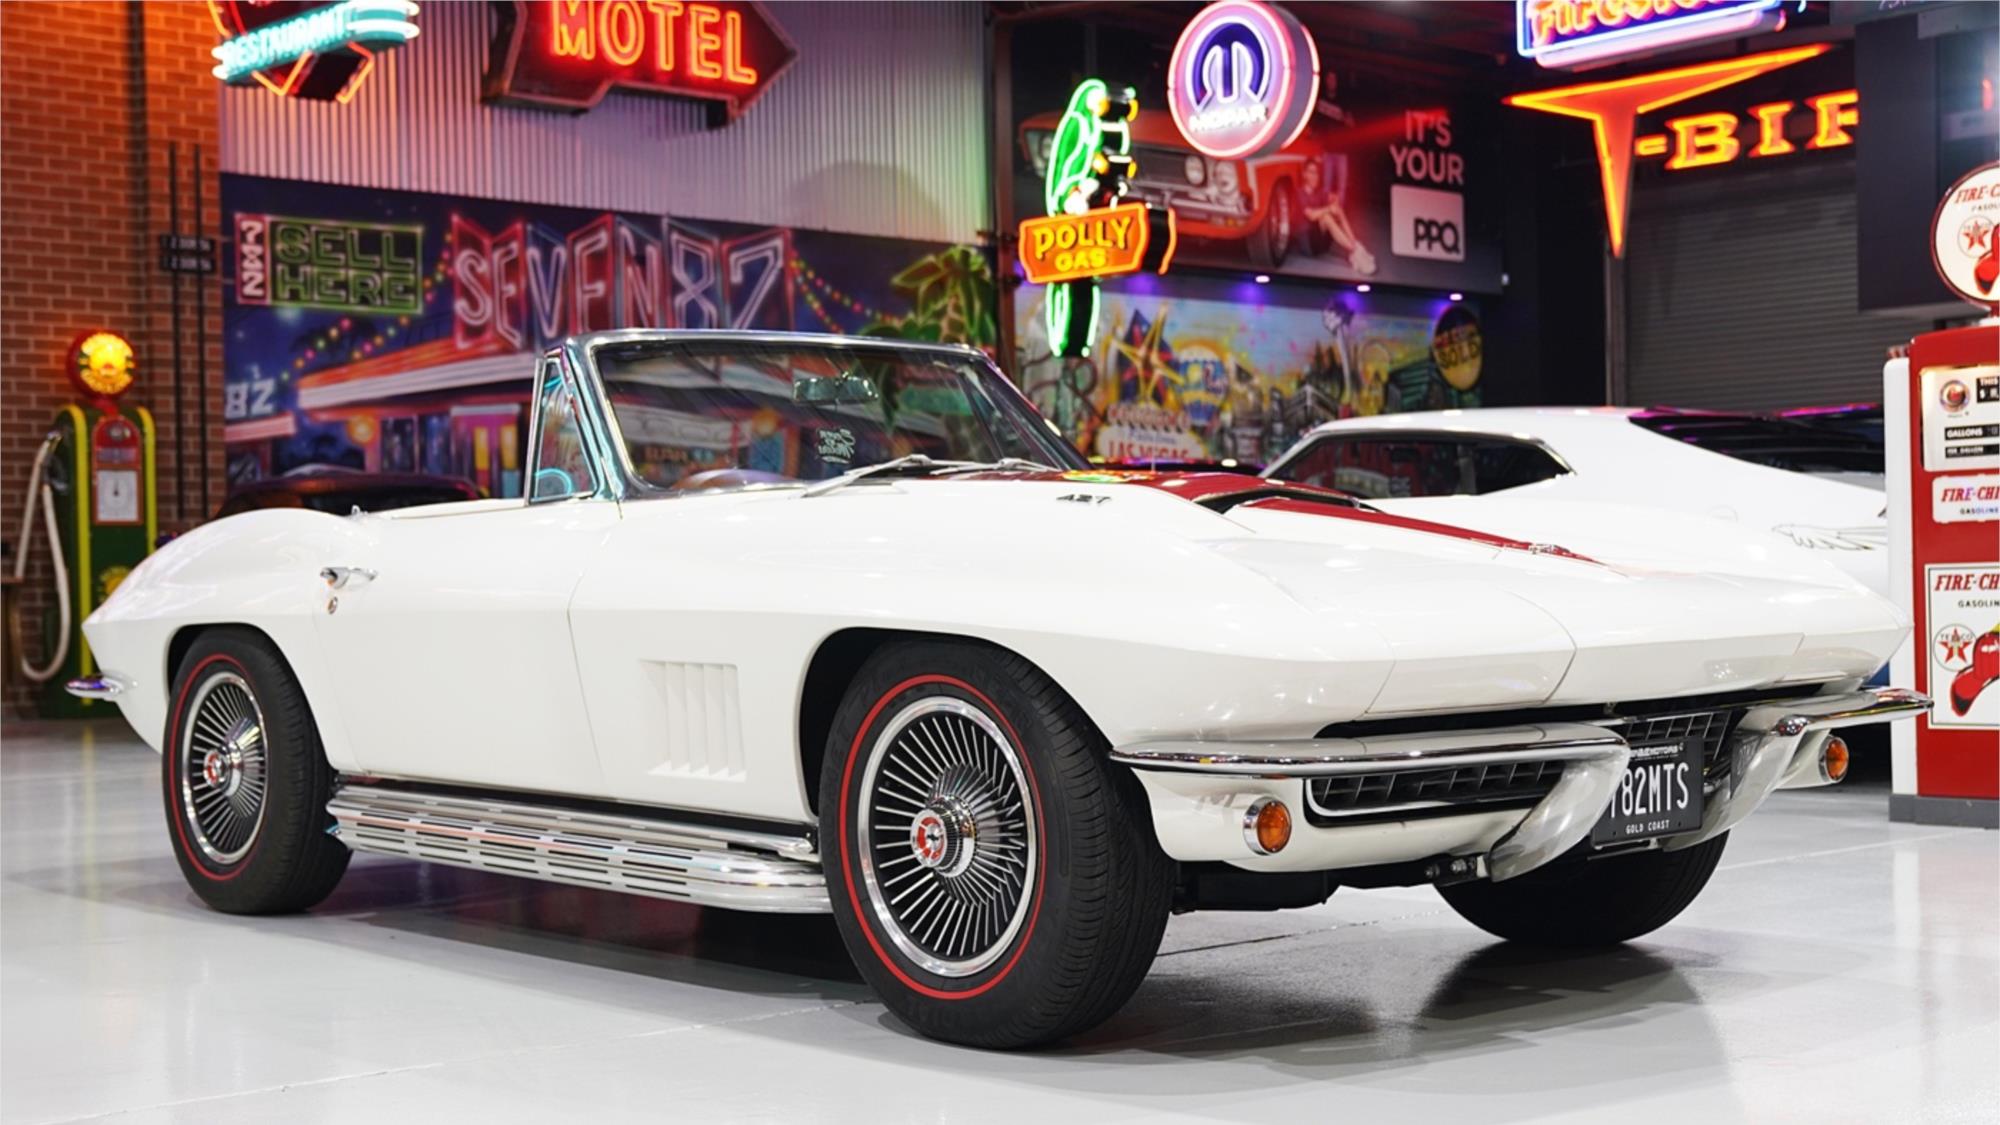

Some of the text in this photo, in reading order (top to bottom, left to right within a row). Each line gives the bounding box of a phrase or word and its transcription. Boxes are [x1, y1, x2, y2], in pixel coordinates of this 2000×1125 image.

[222, 3, 348, 72] RESTAURANT
[551, 0, 757, 85] MOTEL
[1405, 109, 1452, 148] IT'S
[1390, 144, 1464, 185] YOUR
[275, 223, 415, 271] SELL
[1032, 216, 1132, 260] POLLY
[1413, 216, 1461, 255] PPQ
[1055, 247, 1108, 272] GAS
[275, 264, 416, 312] HERE
[1946, 427, 1983, 438] GALLONS
[1056, 494, 1111, 504] 427
[1611, 762, 1690, 818] 82MTS
[1625, 820, 1670, 834] GOLD COAST
